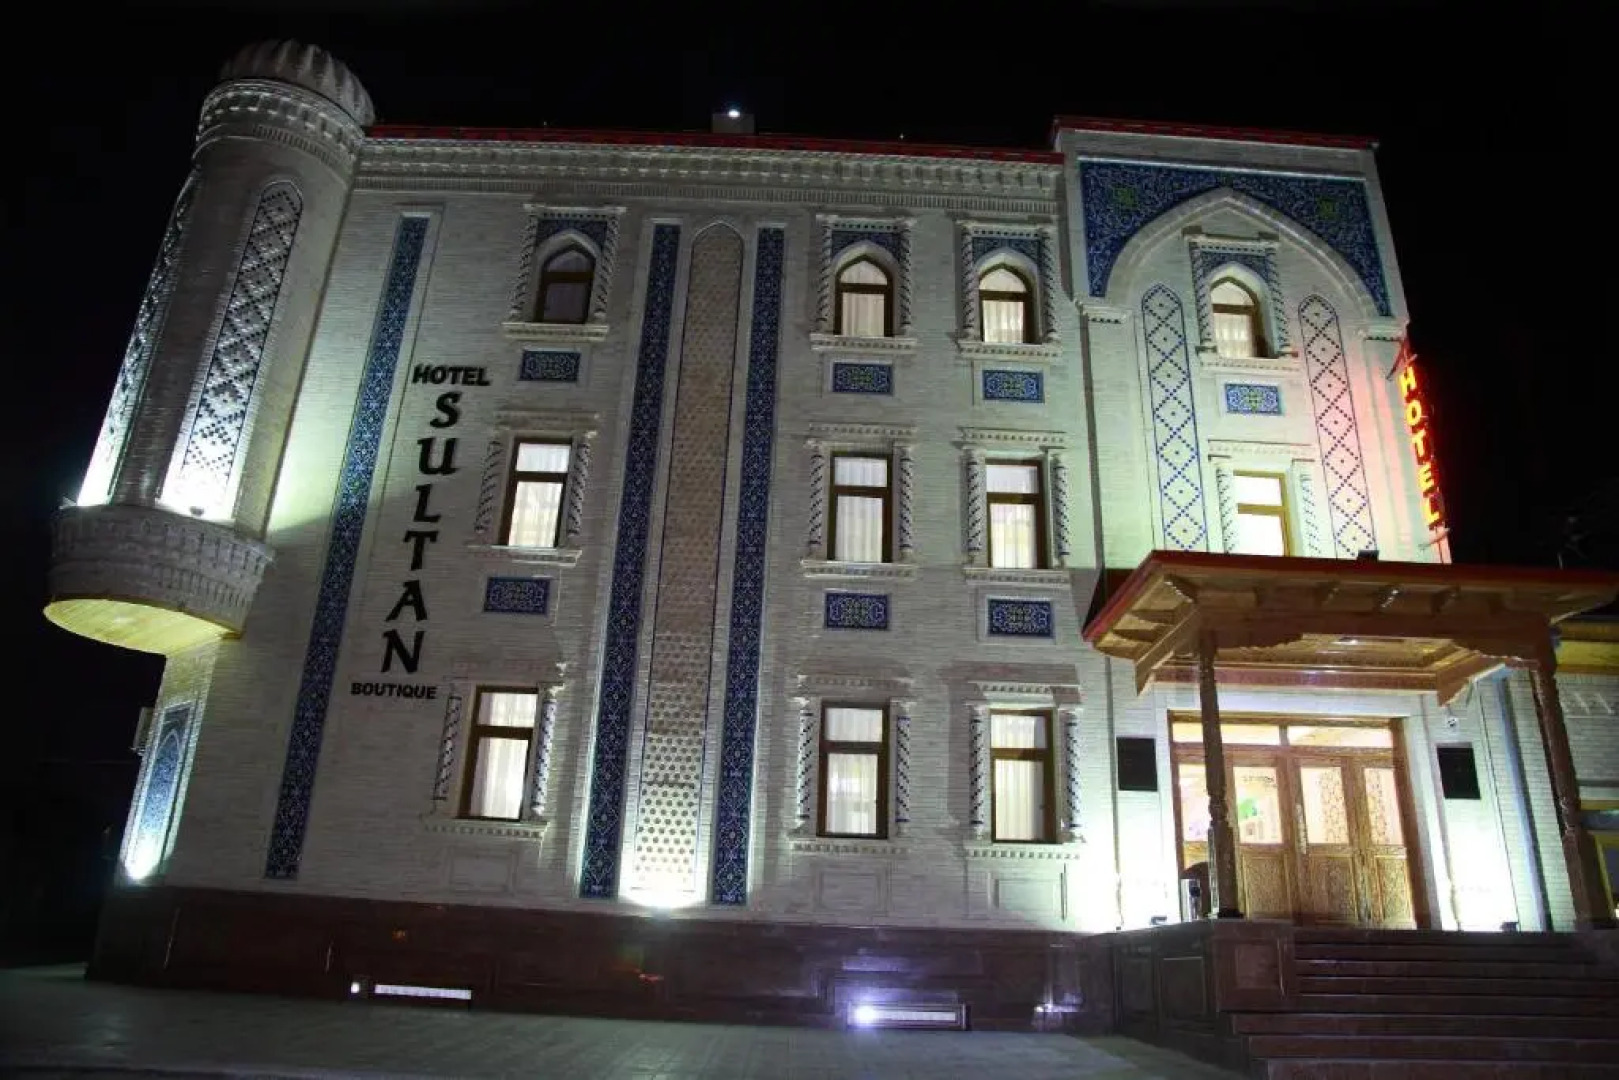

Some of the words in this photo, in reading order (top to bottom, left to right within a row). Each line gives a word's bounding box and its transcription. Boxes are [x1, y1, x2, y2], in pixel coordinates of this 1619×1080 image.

[413, 364, 491, 386] HOTEL
[1398, 364, 1442, 526] HOTEL
[380, 391, 462, 674] SULTAN
[350, 682, 437, 699] BOUTIQUE
